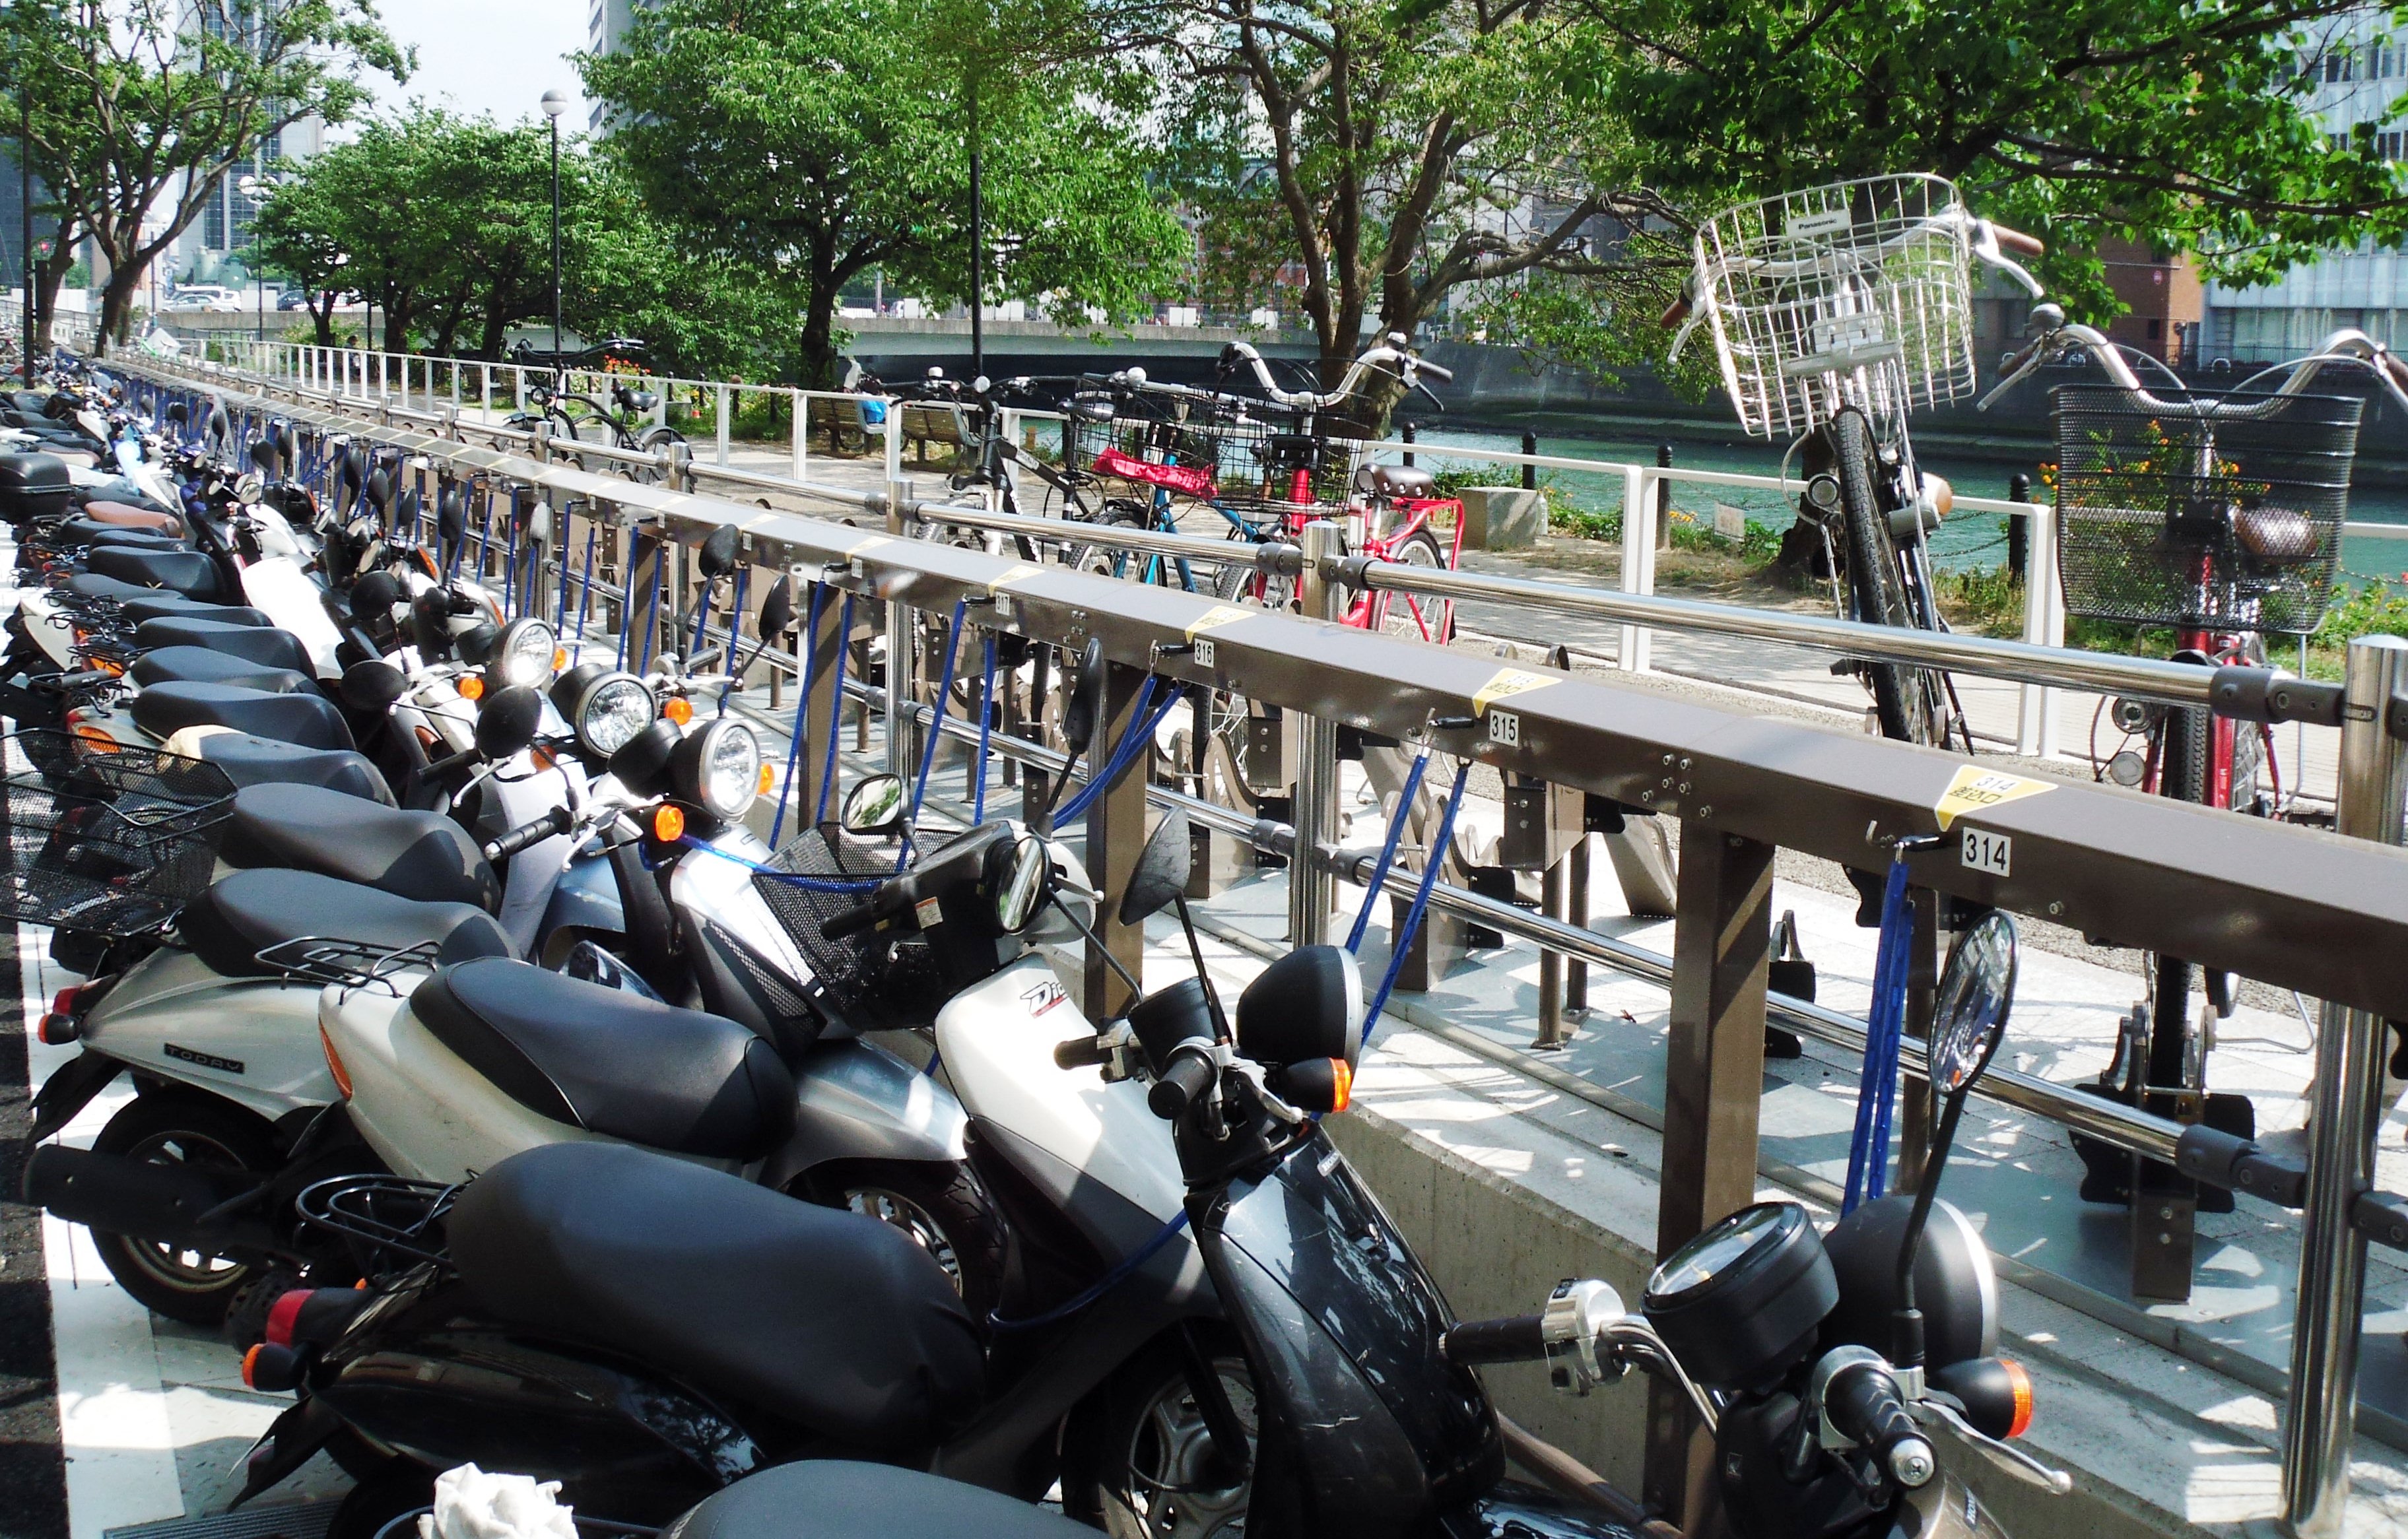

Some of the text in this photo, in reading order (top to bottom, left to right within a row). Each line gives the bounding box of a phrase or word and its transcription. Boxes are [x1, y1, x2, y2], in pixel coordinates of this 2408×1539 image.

[1799, 218, 1837, 230] Panasonic
[997, 595, 1009, 614] 317
[1196, 643, 1212, 663] 316
[1492, 715, 1516, 741] 315
[1976, 777, 2016, 791] 314
[1947, 785, 2003, 804] 差込口
[1966, 834, 2007, 870] 314
[168, 1045, 240, 1070] TODAY
